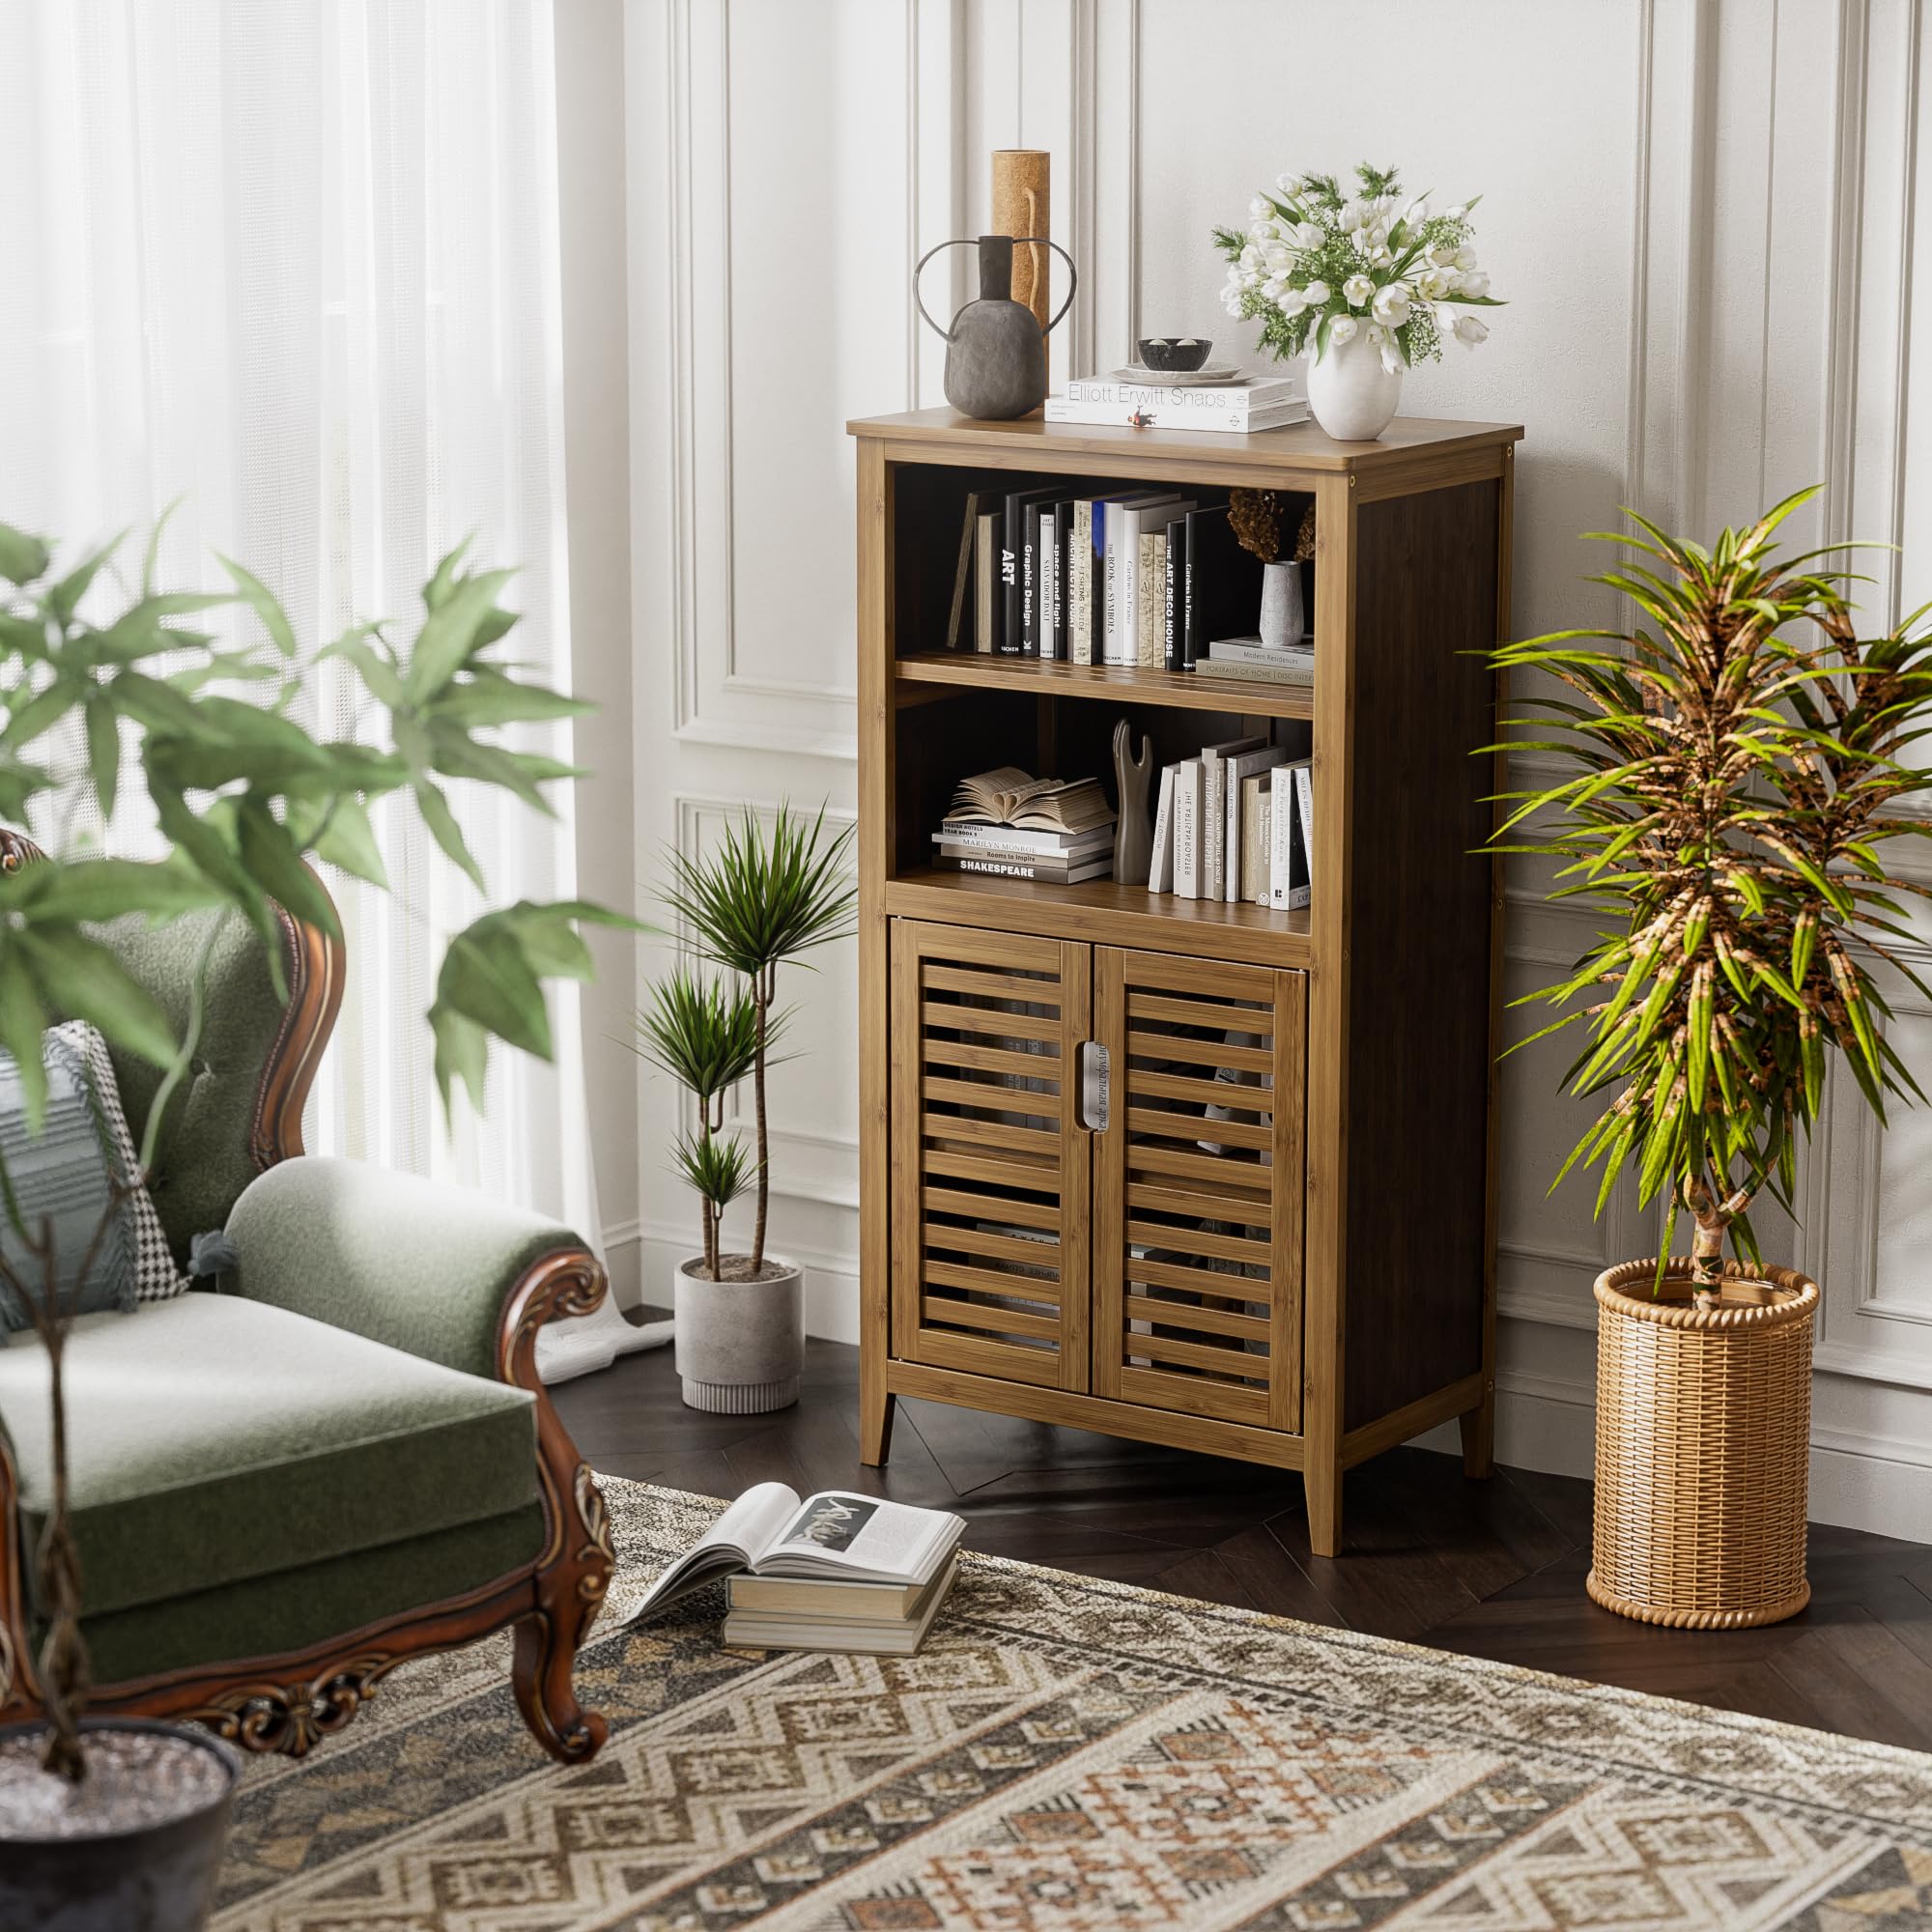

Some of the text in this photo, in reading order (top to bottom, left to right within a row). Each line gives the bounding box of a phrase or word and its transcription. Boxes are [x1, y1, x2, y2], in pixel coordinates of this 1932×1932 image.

[1068, 384, 1227, 409] Elliott Erwitt Snaps
[1002, 549, 1015, 584] ART
[1024, 545, 1034, 626] Graphic Design
[1244, 651, 1298, 665] Modern Residences
[1206, 666, 1239, 675] PORTRAITS
[962, 838, 1037, 853] MARILYN MONROE
[987, 851, 1007, 860] Rooms
[1015, 852, 1036, 863] Inspire
[960, 860, 1035, 877] SHAKESPEARE
